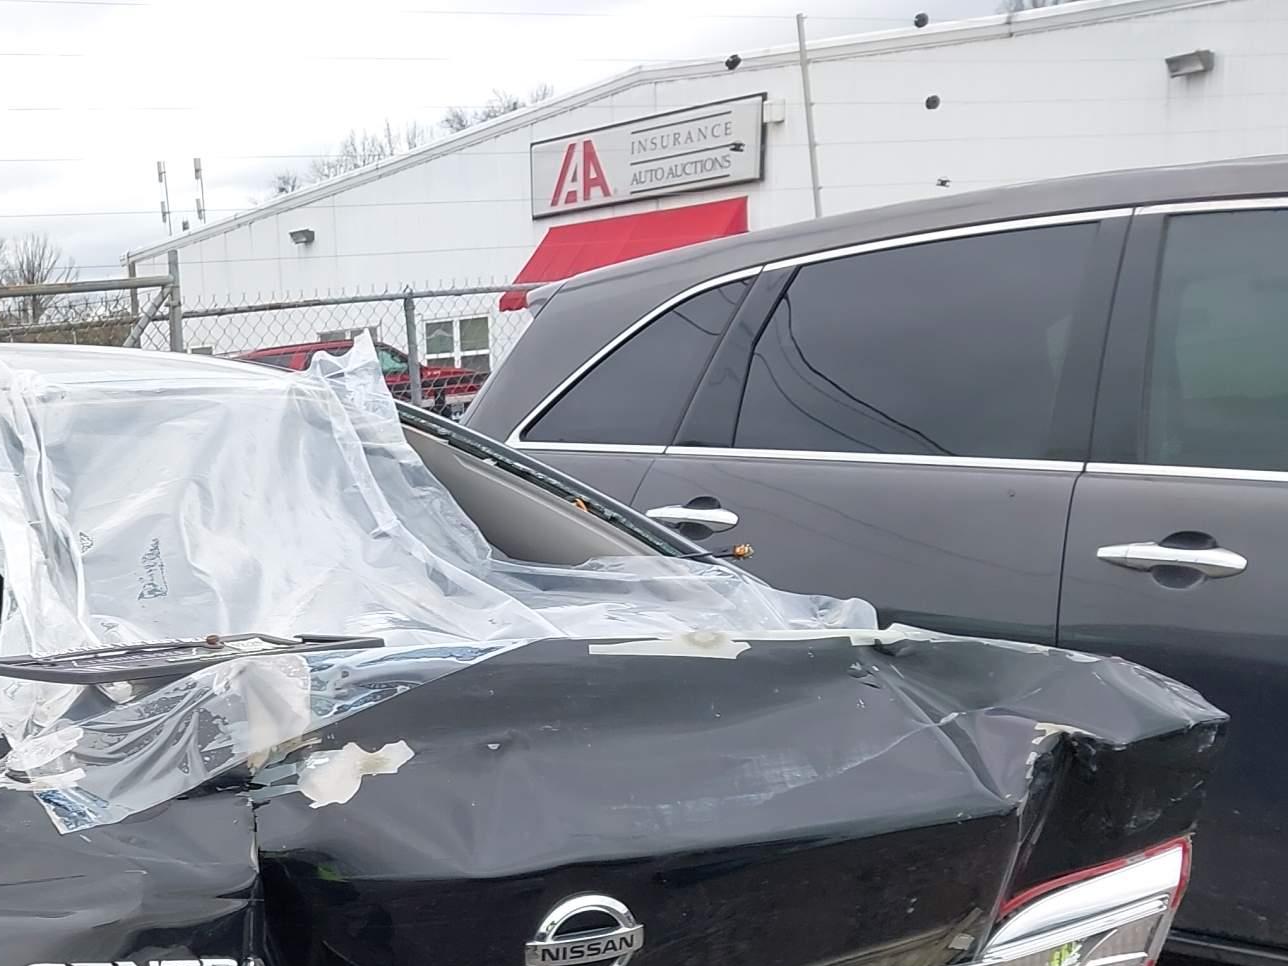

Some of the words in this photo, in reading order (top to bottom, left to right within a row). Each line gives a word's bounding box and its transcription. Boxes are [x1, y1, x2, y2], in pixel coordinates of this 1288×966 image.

[630, 120, 733, 155] INSURANCE
[630, 166, 665, 186] AUTO
[666, 154, 732, 181] AUCTIONS
[540, 933, 635, 963] NISSAN
